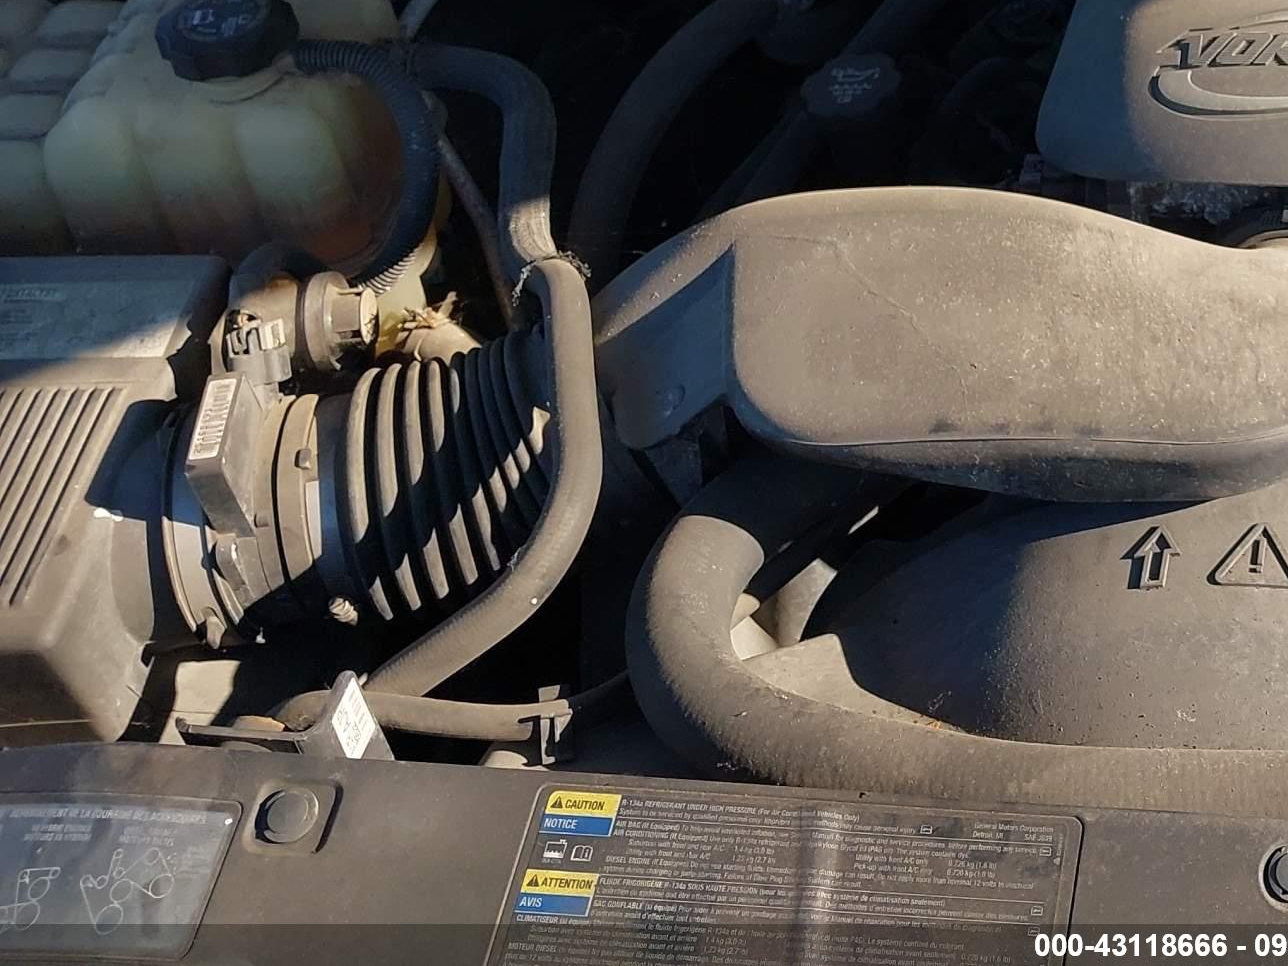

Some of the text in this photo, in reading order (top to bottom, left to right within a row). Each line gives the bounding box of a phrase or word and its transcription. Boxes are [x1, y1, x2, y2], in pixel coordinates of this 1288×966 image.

[565, 798, 605, 811] CAUTION
[644, 801, 685, 810] REFRIGERANT
[687, 802, 708, 811] UNDER
[709, 804, 724, 812] HIGH
[725, 805, 757, 814] PRESSURE
[757, 808, 771, 816] (For
[817, 811, 843, 819] Vehicles
[843, 813, 860, 822] Only)
[543, 818, 579, 830] NOTICE
[998, 822, 1019, 831] Motors
[1019, 824, 1054, 834] Corporation
[625, 830, 669, 839] CONDITIONING
[968, 844, 1002, 853] performing
[605, 855, 627, 864] DIESEL
[628, 856, 650, 865] ENGINE
[541, 877, 594, 890] ATTENTION
[599, 877, 621, 886] FLUIDE
[687, 883, 705, 891] SOUS
[705, 884, 726, 893] HAUTE
[726, 885, 758, 894] PRESSION
[519, 896, 543, 908] AVIS
[606, 901, 644, 910] GONFLABLE
[516, 914, 559, 923] CLIMATISEUR
